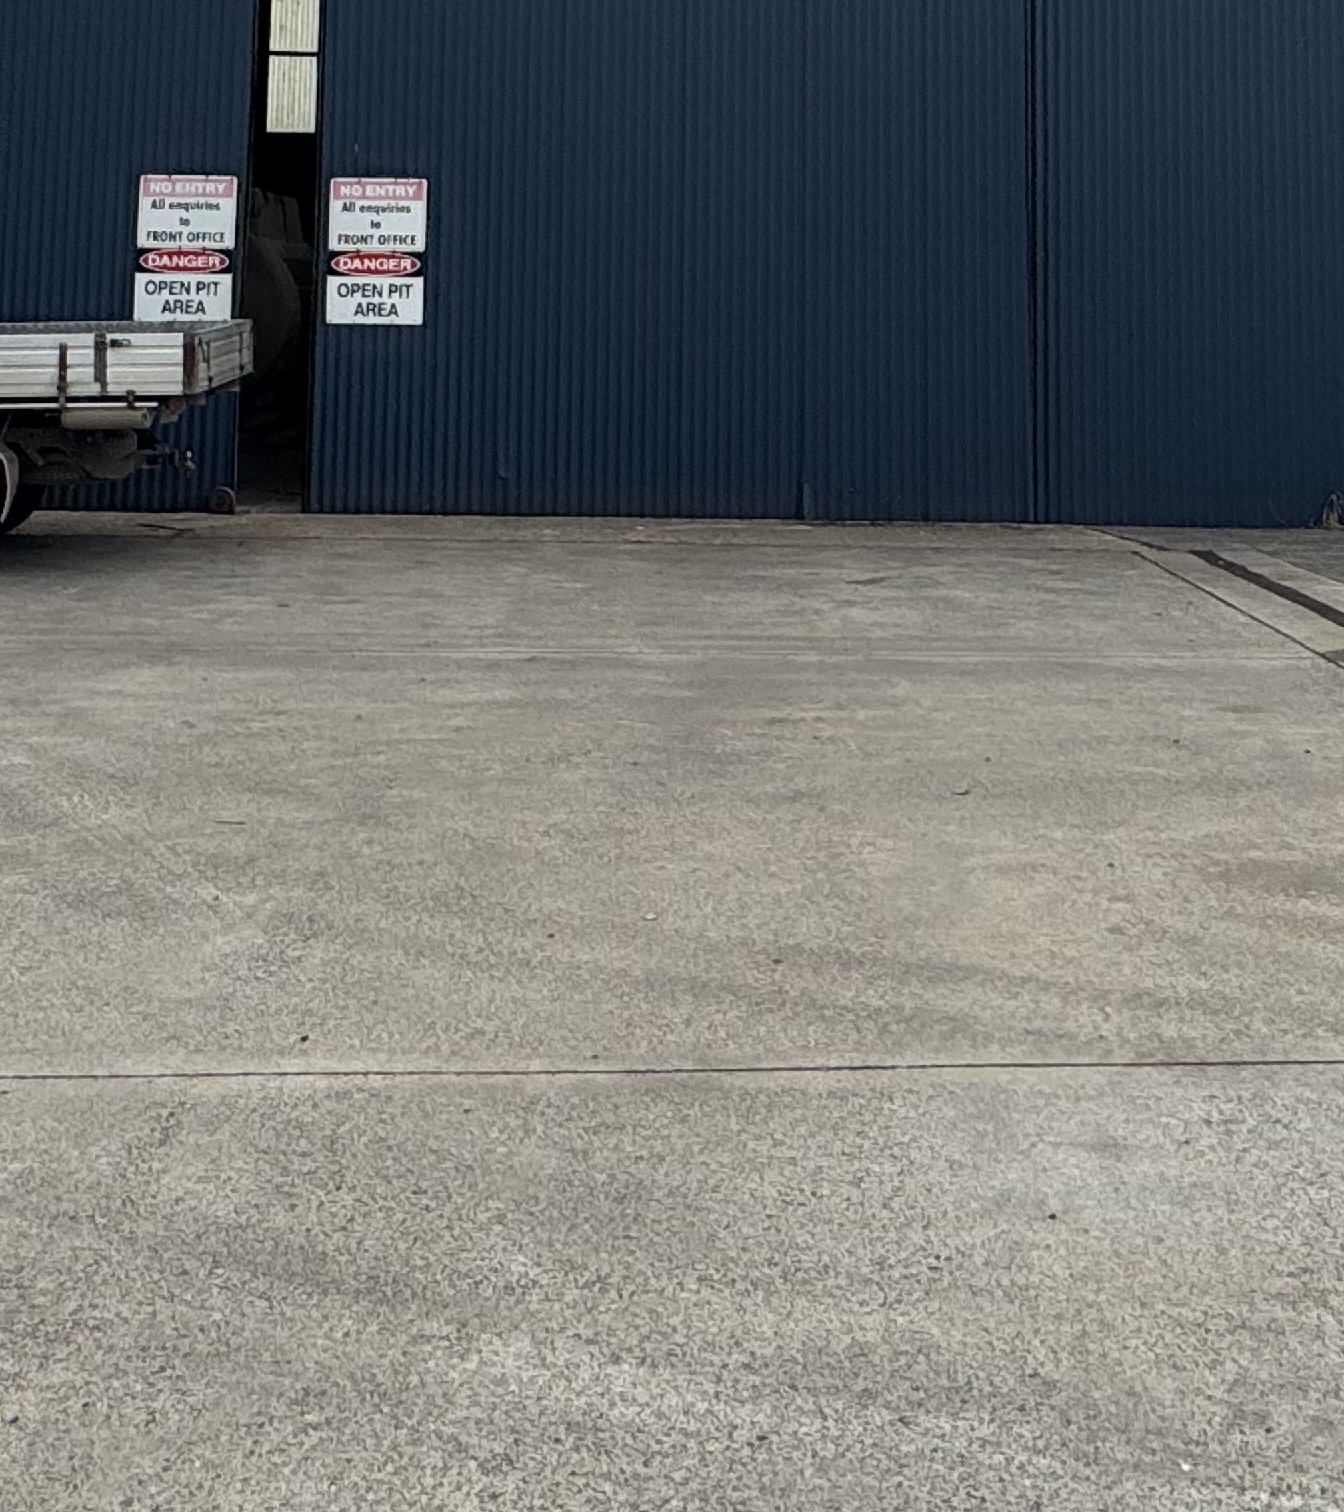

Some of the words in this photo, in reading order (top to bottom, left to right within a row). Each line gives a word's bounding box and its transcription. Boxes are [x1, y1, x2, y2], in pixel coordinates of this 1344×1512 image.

[150, 183, 171, 193] NO
[175, 183, 227, 193] ENTRY
[340, 185, 362, 196] NO
[365, 185, 417, 197] ENTRY
[151, 198, 165, 209] All
[169, 200, 221, 213] enquiries
[341, 201, 355, 212] All
[359, 202, 411, 215] enquiries
[178, 217, 191, 226] to
[370, 219, 381, 229] to
[146, 231, 183, 242] FRONT
[186, 232, 225, 243] OFFICE
[337, 233, 373, 245] FRONT
[378, 234, 417, 245] OFFICE
[148, 254, 221, 267] DANGER
[339, 258, 411, 270] DANGER
[144, 279, 191, 295] OPEN
[196, 280, 221, 297] PIT
[337, 283, 383, 298] OPEN
[388, 283, 413, 299] PIT
[161, 299, 206, 315] AREA
[353, 302, 399, 317] AREA
